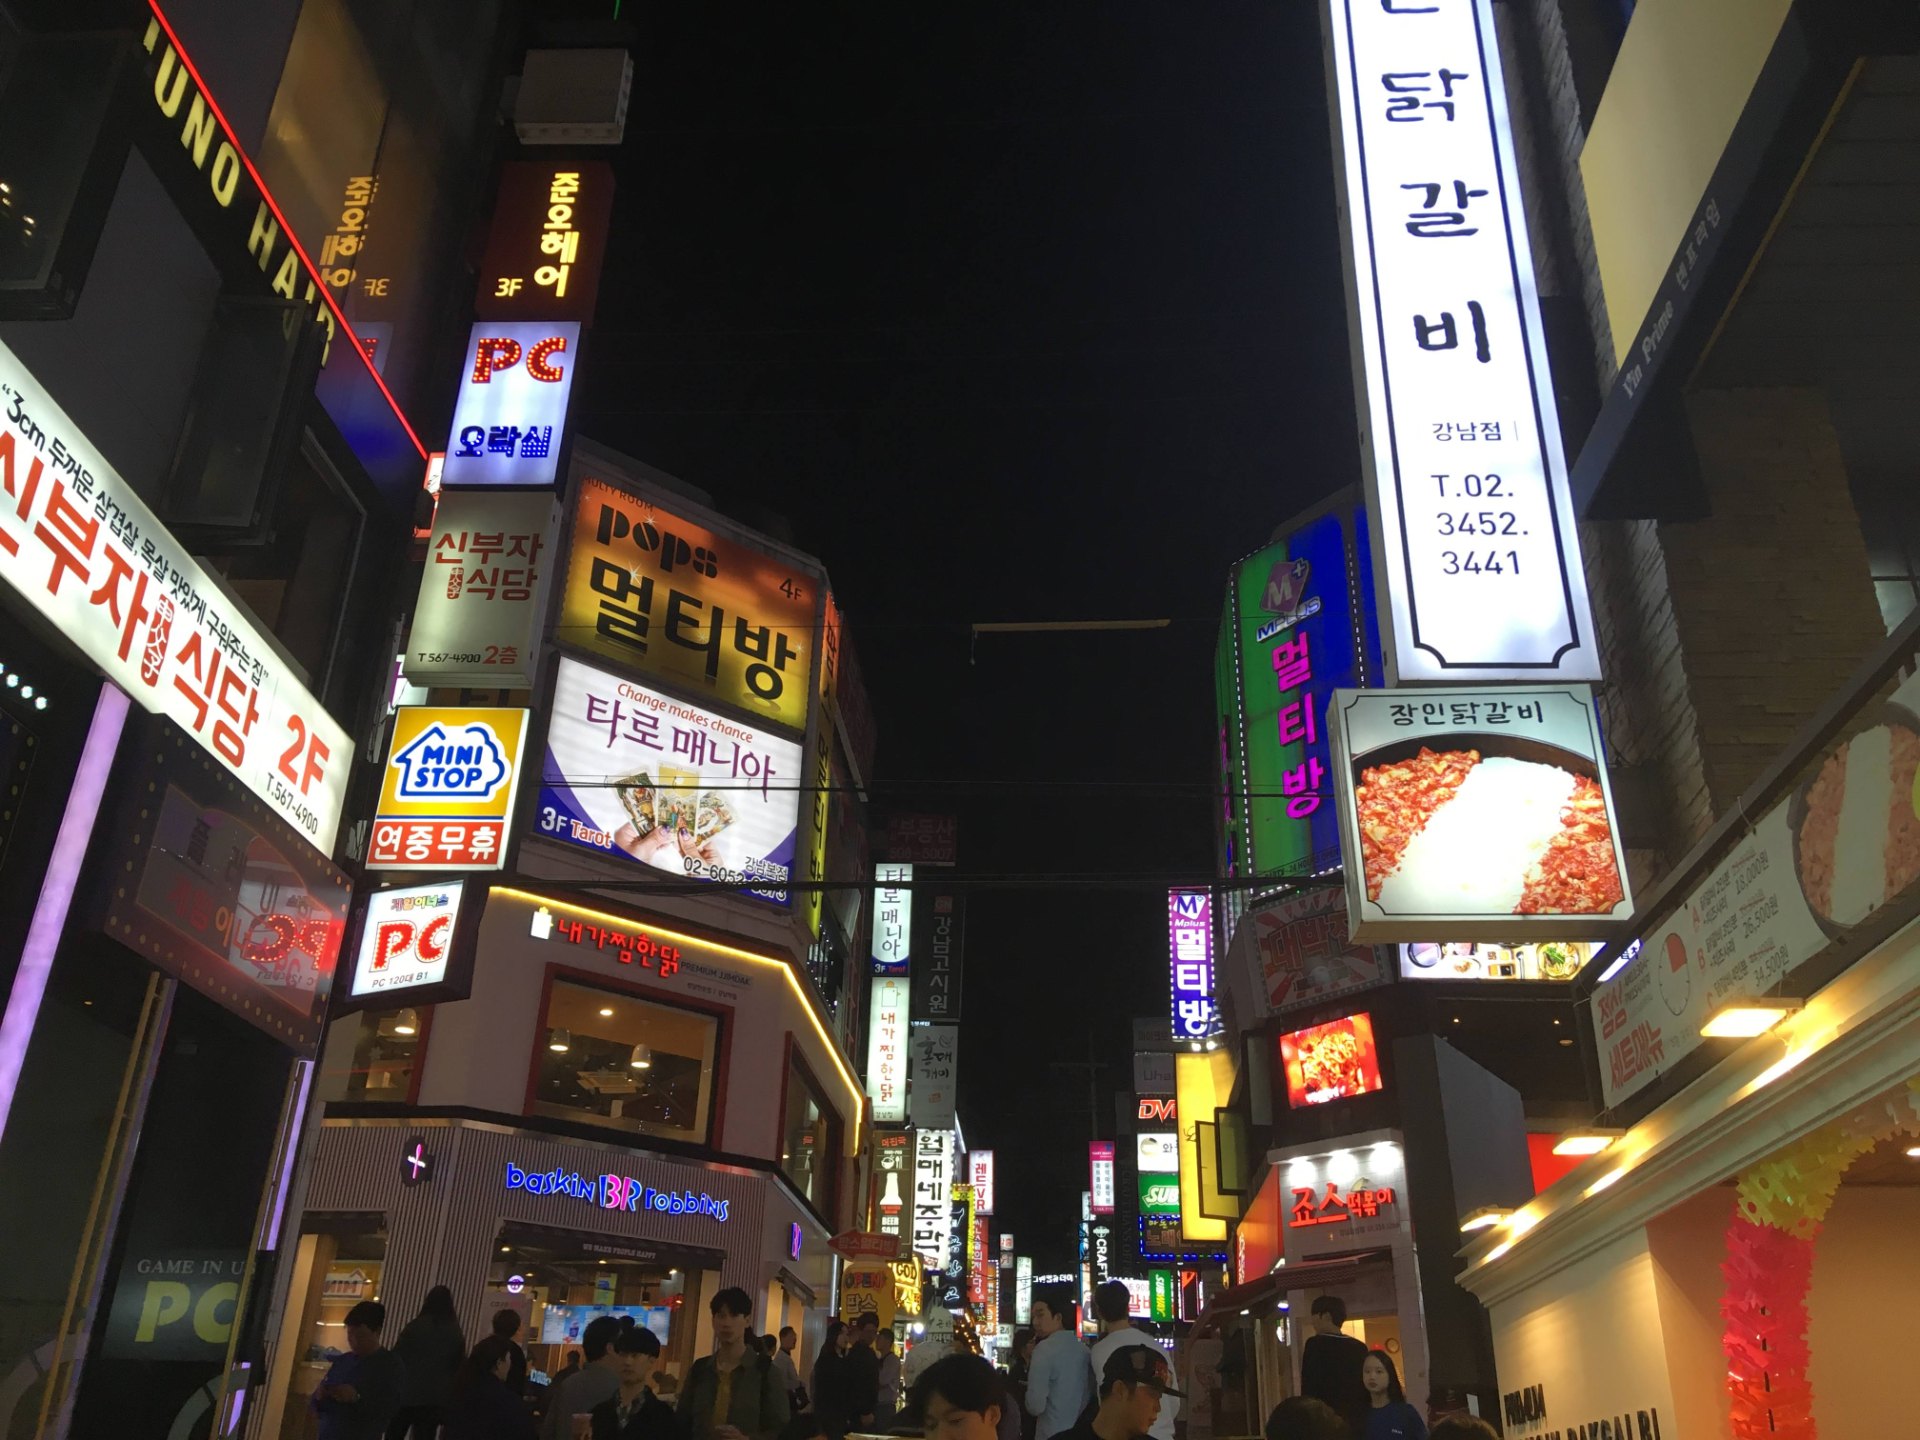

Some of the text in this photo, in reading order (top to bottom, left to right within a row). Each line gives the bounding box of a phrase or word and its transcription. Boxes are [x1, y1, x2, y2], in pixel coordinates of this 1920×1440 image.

[1381, 0, 1490, 363] 닭갈비
[534, 172, 580, 297] 준오헤어
[495, 278, 523, 297] 3F
[472, 337, 567, 383] PC
[455, 426, 552, 458] 오락실
[1432, 421, 1502, 441] 강남점
[619, 488, 654, 512] ROOM
[597, 504, 718, 579] pops
[1437, 512, 1528, 536] 3452.
[48, 437, 94, 504] 두꺼운
[140, 538, 170, 585] 목살
[170, 567, 207, 626] 맛있게
[206, 609, 251, 674] 구워주는
[435, 532, 544, 565] 신부자
[1442, 551, 1520, 575] 3441
[466, 568, 538, 600] 식당
[779, 578, 803, 599] 4F
[590, 556, 797, 701] 멀티방
[483, 646, 518, 665] 2층
[173, 631, 260, 769] 식당
[278, 714, 331, 797] 2F
[617, 682, 754, 744] Change makes chance
[1272, 631, 1325, 819] 멀티방
[1390, 701, 1544, 726] 장인닭갈비
[422, 745, 484, 766] MINI
[585, 693, 777, 802] 타로 매니아
[414, 767, 483, 788] STOP
[267, 772, 319, 836] T.567-4900
[374, 825, 497, 861] 연중무휴
[541, 807, 613, 849] 3F Tarot
[1174, 918, 1206, 927] Mplus
[369, 912, 453, 973] PC
[558, 918, 681, 978] 내가찜한닭
[372, 979, 385, 988] PC
[875, 964, 886, 973] 3F
[929, 916, 952, 1014] 강남고시원
[1176, 929, 1212, 1035] 멀티방
[879, 1012, 896, 1102] 내가찜한닭
[506, 1162, 730, 1222] baskin BR robbins
[137, 1259, 194, 1274] GAME
[201, 1260, 223, 1274] IN
[896, 1263, 917, 1280] GOD
[135, 1281, 239, 1344] PC
[846, 1294, 878, 1315] 팝스
[1156, 1274, 1166, 1317] SUBWAY
